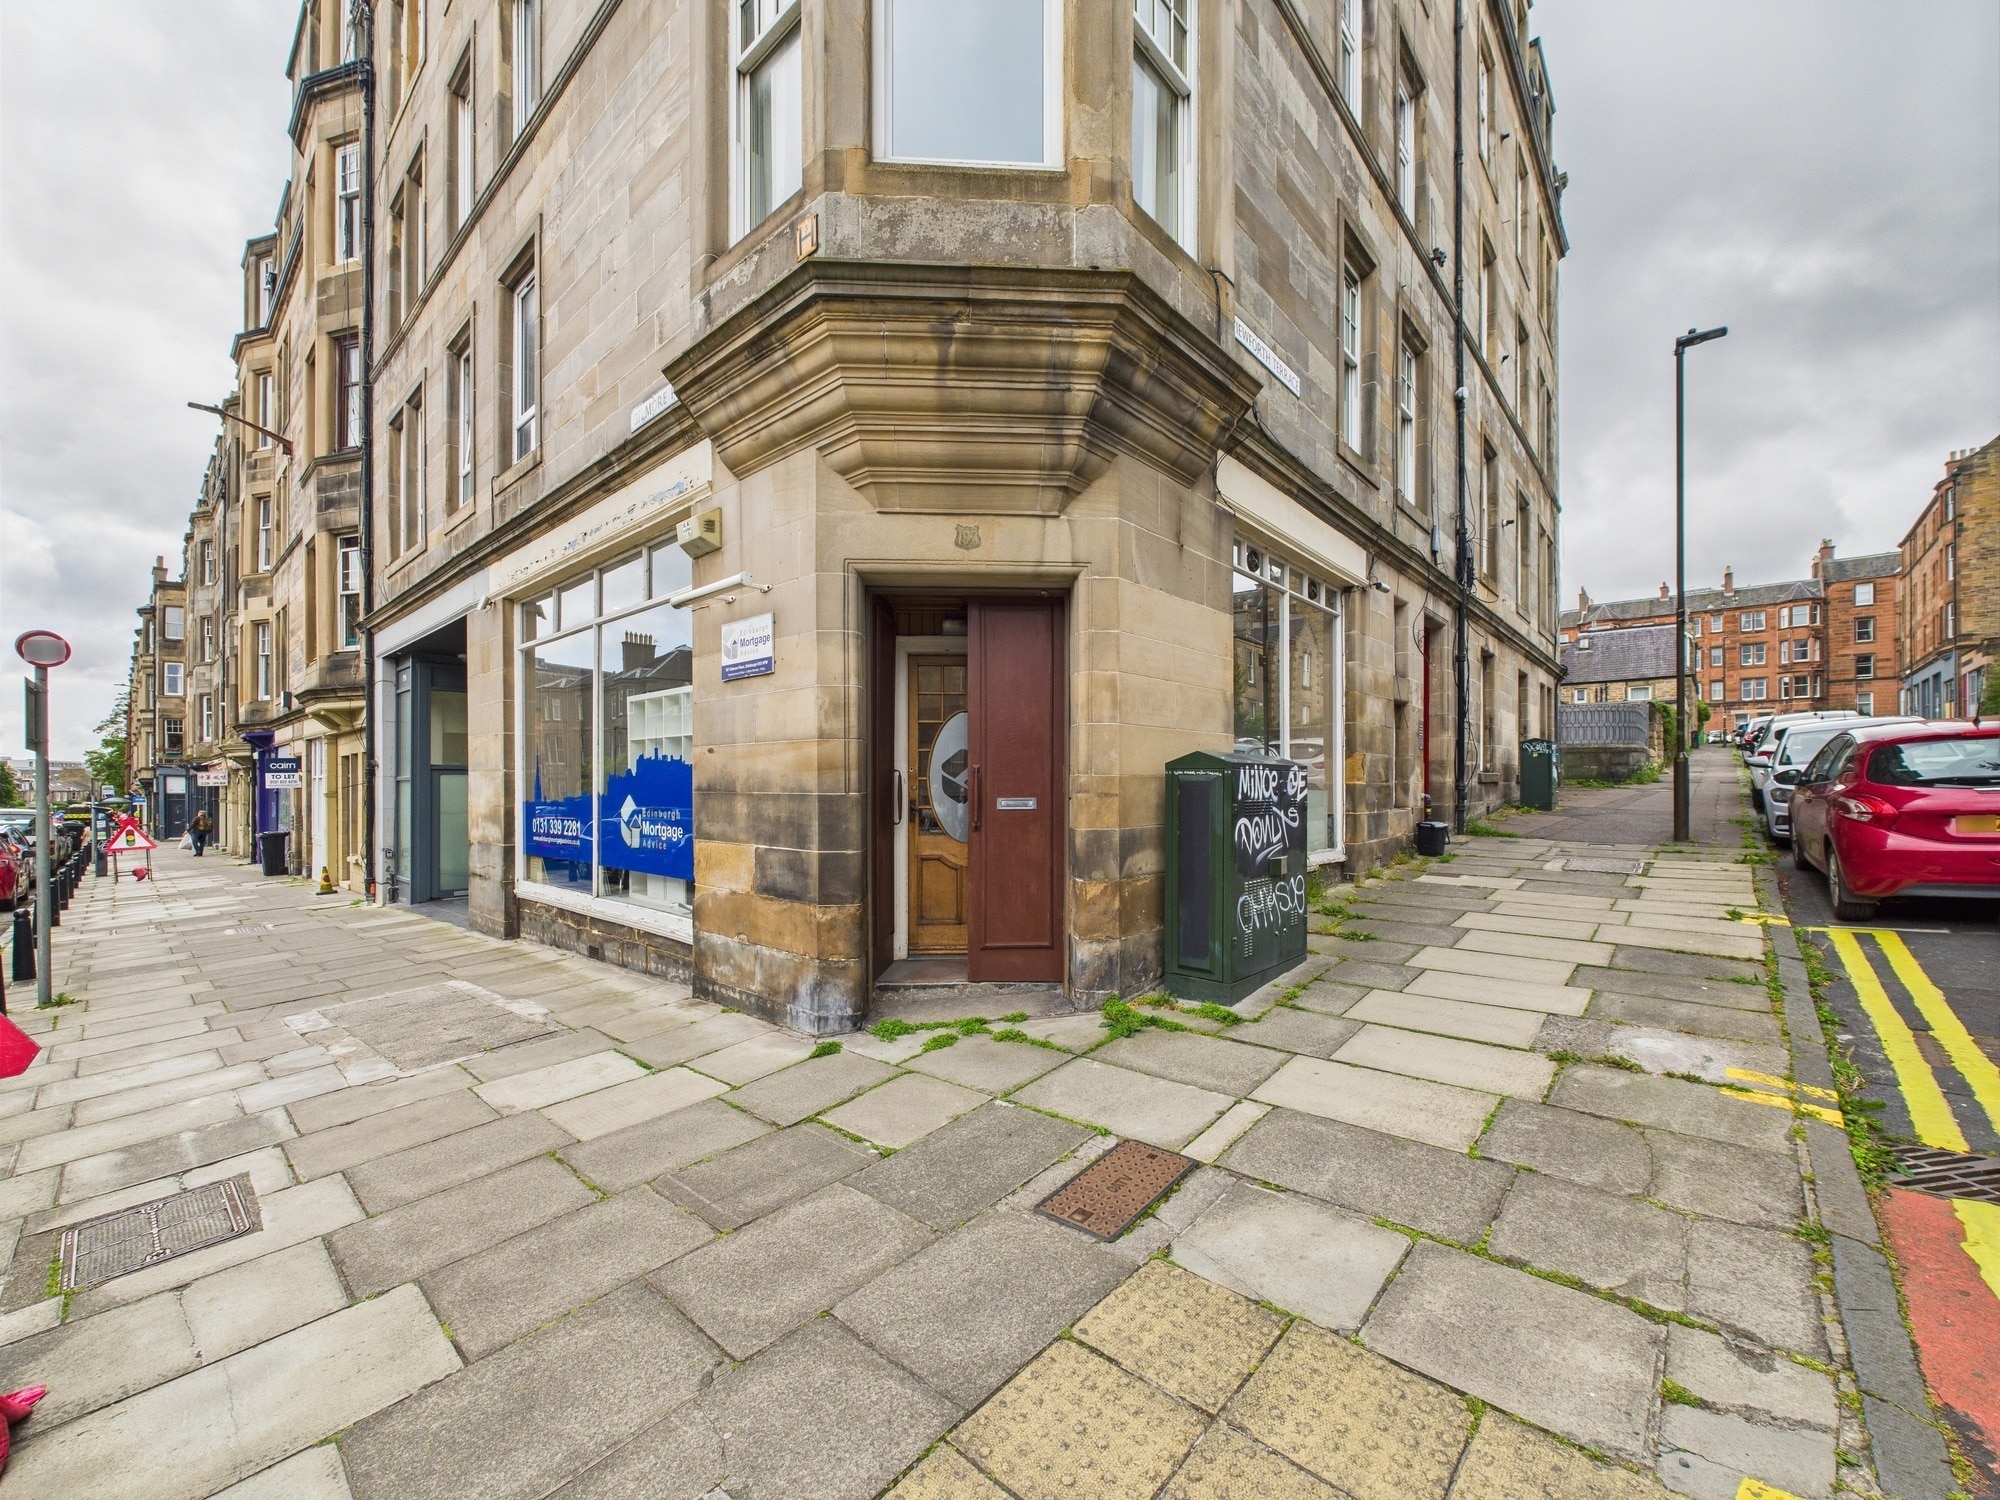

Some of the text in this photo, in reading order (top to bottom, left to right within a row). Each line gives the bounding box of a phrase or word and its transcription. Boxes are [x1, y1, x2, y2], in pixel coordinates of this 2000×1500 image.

[1236, 321, 1299, 393] IEWFORTH TERRACE
[740, 624, 769, 637] Edinburgh
[740, 634, 770, 648] Mortgage
[270, 761, 296, 769] cairn
[642, 807, 681, 821] Edinburgh
[533, 818, 580, 836] 0131 339 2281
[642, 820, 683, 841] Mortgage
[643, 838, 667, 850] Advice
[1106, 1173, 1133, 1193] CATV
